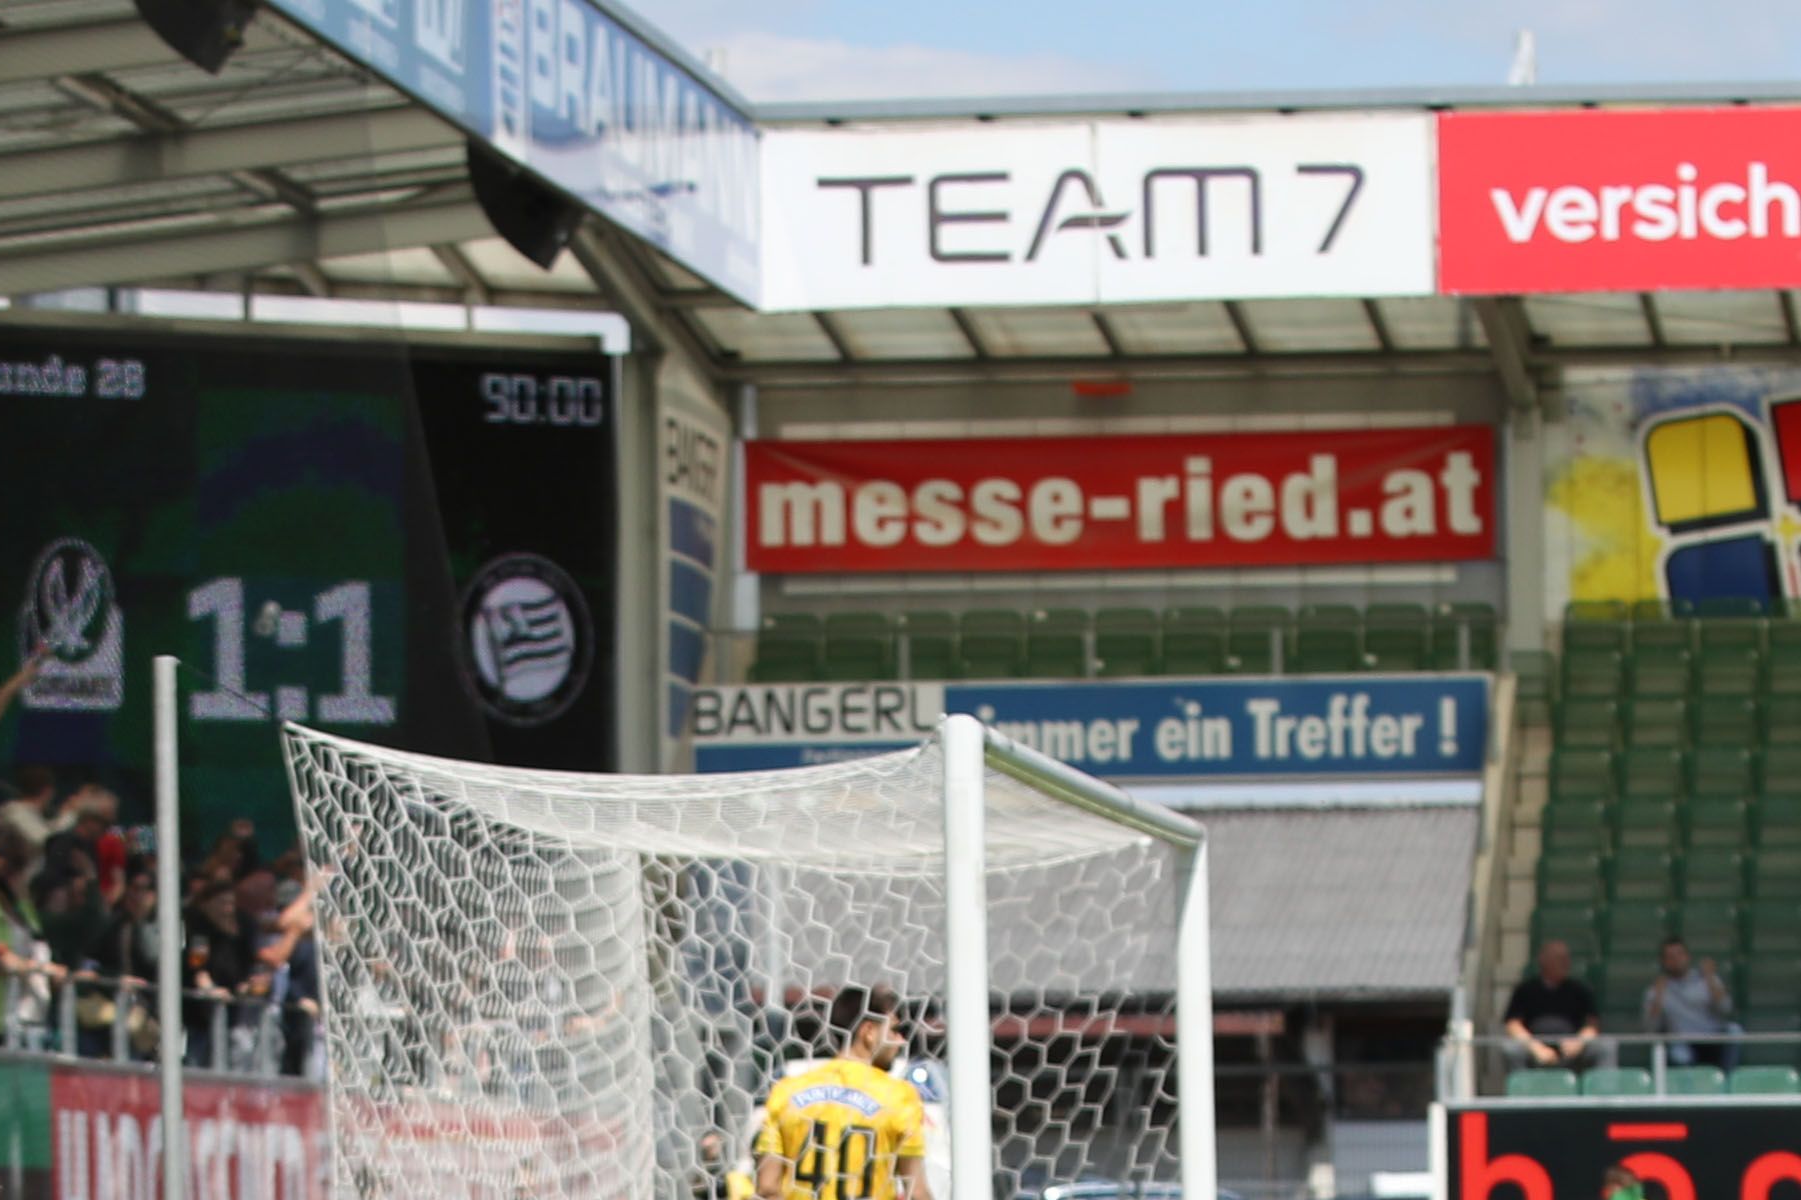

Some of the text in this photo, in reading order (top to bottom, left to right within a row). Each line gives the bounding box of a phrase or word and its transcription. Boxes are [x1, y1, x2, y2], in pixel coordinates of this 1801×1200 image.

[816, 163, 1366, 266] TEAM 7
[1489, 162, 1801, 244] versich
[94, 358, 147, 399] 28
[479, 372, 602, 426] 90:00
[757, 450, 1484, 547] messe-ried.at
[186, 575, 399, 725] 1:1
[691, 686, 938, 738] BANGERL
[1155, 699, 1233, 759] ein
[1249, 693, 1425, 763] Treffer
[1438, 694, 1460, 757] !
